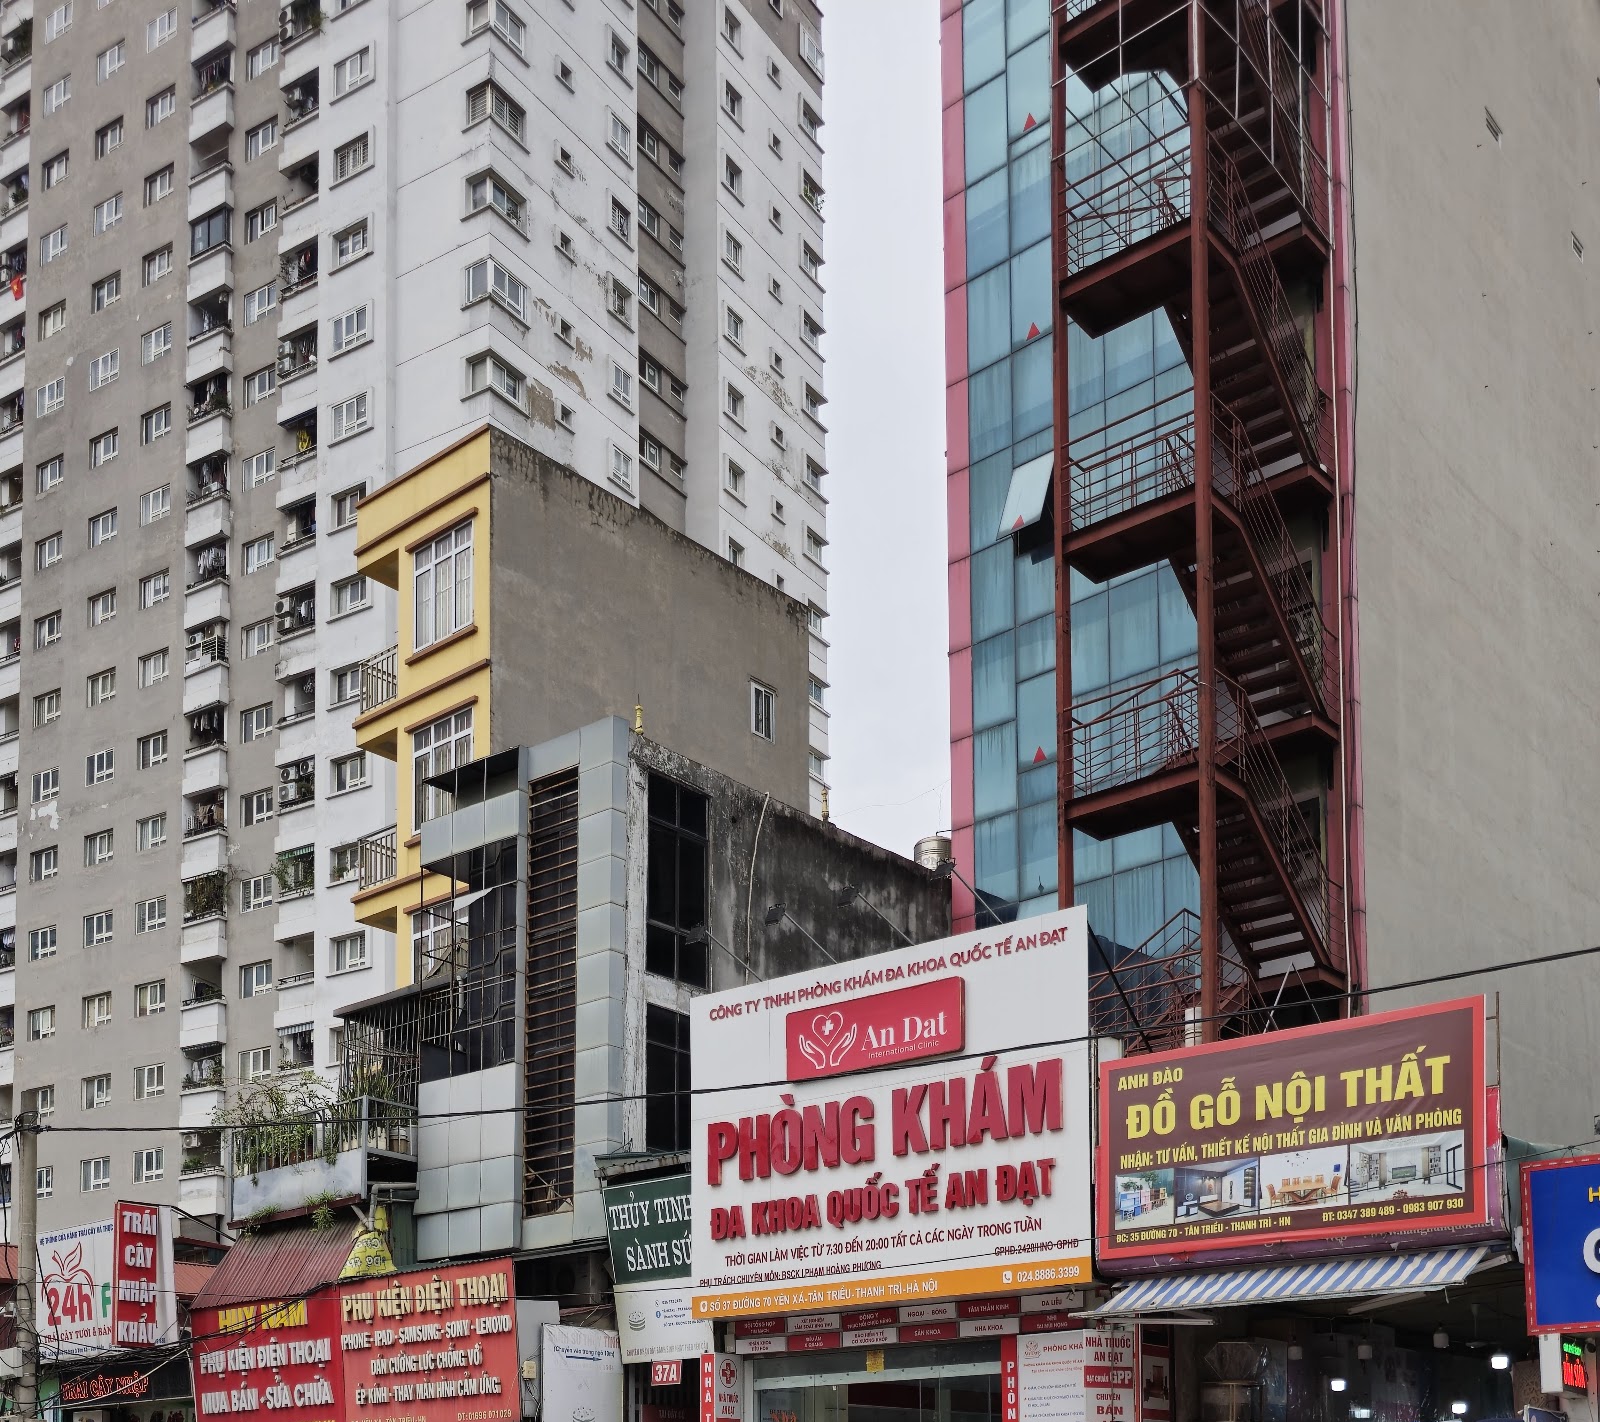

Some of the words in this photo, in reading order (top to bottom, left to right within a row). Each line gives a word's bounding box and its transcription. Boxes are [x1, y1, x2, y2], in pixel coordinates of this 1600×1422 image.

[709, 1003, 742, 1022] CÔNG
[745, 998, 761, 1014] TY
[763, 992, 796, 1011] TNHH
[797, 977, 842, 1004] PHÒNG
[844, 968, 884, 993] KHÁM
[885, 965, 905, 983] ĐA
[907, 955, 948, 977] KHOA
[949, 943, 993, 969] QUỐC
[995, 934, 1014, 957] TẾ
[1015, 931, 1038, 953] AN
[1039, 926, 1069, 947] ĐẠT
[861, 1024, 895, 1052] An
[902, 1010, 948, 1040] Dat
[868, 1043, 917, 1060] International
[917, 1038, 940, 1052] Clinic
[1118, 1072, 1149, 1092] ANH
[1152, 1066, 1184, 1088] ĐÀO
[1125, 1087, 1176, 1140] ĐỒ
[1189, 1076, 1241, 1129] GỖ
[1255, 1071, 1326, 1124] NỘI
[1340, 1045, 1451, 1108] THẤT
[707, 1093, 876, 1187] PHÒNG
[891, 1055, 1064, 1157] KHÁM
[1120, 1153, 1153, 1172] NHẬN:
[1155, 1147, 1171, 1164] TƯ
[1172, 1142, 1198, 1163] VẤN,
[1201, 1134, 1231, 1159] THIẾT
[1234, 1131, 1251, 1154] KẾ
[1252, 1131, 1273, 1154] NỘI
[1276, 1124, 1305, 1150] THẤT
[1308, 1127, 1329, 1144] GIA
[1332, 1119, 1362, 1140] ĐÌNH
[1365, 1116, 1384, 1136] VÀ
[1386, 1112, 1413, 1134] VĂN
[1415, 1107, 1463, 1131] PHÒNG
[608, 1191, 650, 1231] THỦY
[710, 1205, 746, 1241] ĐA
[751, 1193, 822, 1237] KHOA
[826, 1171, 900, 1229] QUỐC
[905, 1162, 941, 1215] TẾ
[944, 1168, 989, 1210] AN
[995, 1157, 1057, 1206] ĐẠT
[1322, 1212, 1335, 1222] ĐT:
[1336, 1209, 1358, 1221] 0347
[1360, 1207, 1376, 1218] 389
[1378, 1205, 1395, 1216] 489
[1402, 1202, 1425, 1214] 0983
[1427, 1199, 1444, 1212] 907
[1446, 1197, 1464, 1210] 930
[122, 1210, 157, 1236] TRÁI
[1116, 1234, 1129, 1244] ĐC:
[1129, 1232, 1139, 1242] 35
[1140, 1229, 1167, 1241] ĐƯỜNG
[1168, 1228, 1178, 1239] 70
[1184, 1225, 1200, 1237] TÂN
[1230, 1219, 1257, 1231] THANH
[1258, 1216, 1272, 1229] TRÌ
[1279, 1216, 1291, 1227] HN
[124, 1242, 154, 1269] CÂY
[626, 1237, 671, 1272] SÀNH
[725, 1251, 746, 1267] THỜI
[747, 1249, 768, 1265] GIAN
[769, 1246, 788, 1263] LÀM
[790, 1243, 809, 1261] VIỆC
[811, 1242, 826, 1258] TỪ
[826, 1240, 843, 1256] 7:30
[844, 1235, 863, 1253] ĐẾN
[865, 1236, 889, 1252] 20:00
[891, 1230, 908, 1248] TẤT
[910, 1229, 923, 1246] CẢ
[925, 1226, 945, 1244] CÁC
[947, 1224, 975, 1242] NGÀY
[977, 1221, 1012, 1238] TRONG
[1013, 1215, 1042, 1233] TUẦN
[1017, 1265, 1080, 1283] 024.8886.3399
[47, 1283, 93, 1327] 24h
[119, 1278, 157, 1307] NHẬP
[342, 1291, 374, 1324] PHỤ
[377, 1280, 413, 1320] KIỆN
[415, 1274, 454, 1315] ĐIỆN
[456, 1272, 509, 1308] THOẠI
[709, 1298, 721, 1312] SỐ
[722, 1300, 731, 1311] 37
[732, 1296, 761, 1310] ĐƯỜNG
[763, 1297, 772, 1307] 70
[117, 1312, 158, 1344] KHẨU
[218, 1305, 258, 1333] HUY
[261, 1299, 308, 1330] NAM
[341, 1331, 372, 1350] IPHONE
[375, 1328, 395, 1347] IPAD
[398, 1323, 442, 1345] SAMSUNG
[445, 1319, 470, 1339] SONY
[475, 1314, 512, 1335] LENOVO
[200, 1350, 226, 1379] PHỤ
[227, 1340, 257, 1376] KIỆN
[257, 1336, 288, 1373] ĐIỆN
[288, 1338, 332, 1368] THOẠI
[1085, 1334, 1103, 1348] NHÀ
[1104, 1333, 1131, 1349] THUỐC
[1094, 1351, 1106, 1362] AN
[1107, 1351, 1124, 1365] ĐẠT
[370, 1352, 390, 1376] DÁN
[388, 1350, 418, 1374] CƯỜNG
[436, 1342, 467, 1370] CHỐNG
[654, 1364, 678, 1383] 37A
[61, 1376, 89, 1400] TRÁI
[90, 1374, 113, 1397] CÂY
[201, 1391, 231, 1415] MUA
[231, 1380, 259, 1412] BÁN
[266, 1374, 294, 1410] SỬA
[294, 1374, 335, 1407] CHỮA
[355, 1383, 368, 1405] ÉP
[368, 1382, 390, 1404] KÍNH
[393, 1383, 414, 1403] THAY
[415, 1377, 436, 1400] MÀN
[436, 1375, 456, 1398] HÌNH
[457, 1371, 479, 1396] CẢM
[479, 1370, 502, 1394] ỨNG
[704, 1361, 712, 1403] NHÀ
[1096, 1404, 1124, 1416] BÁN
